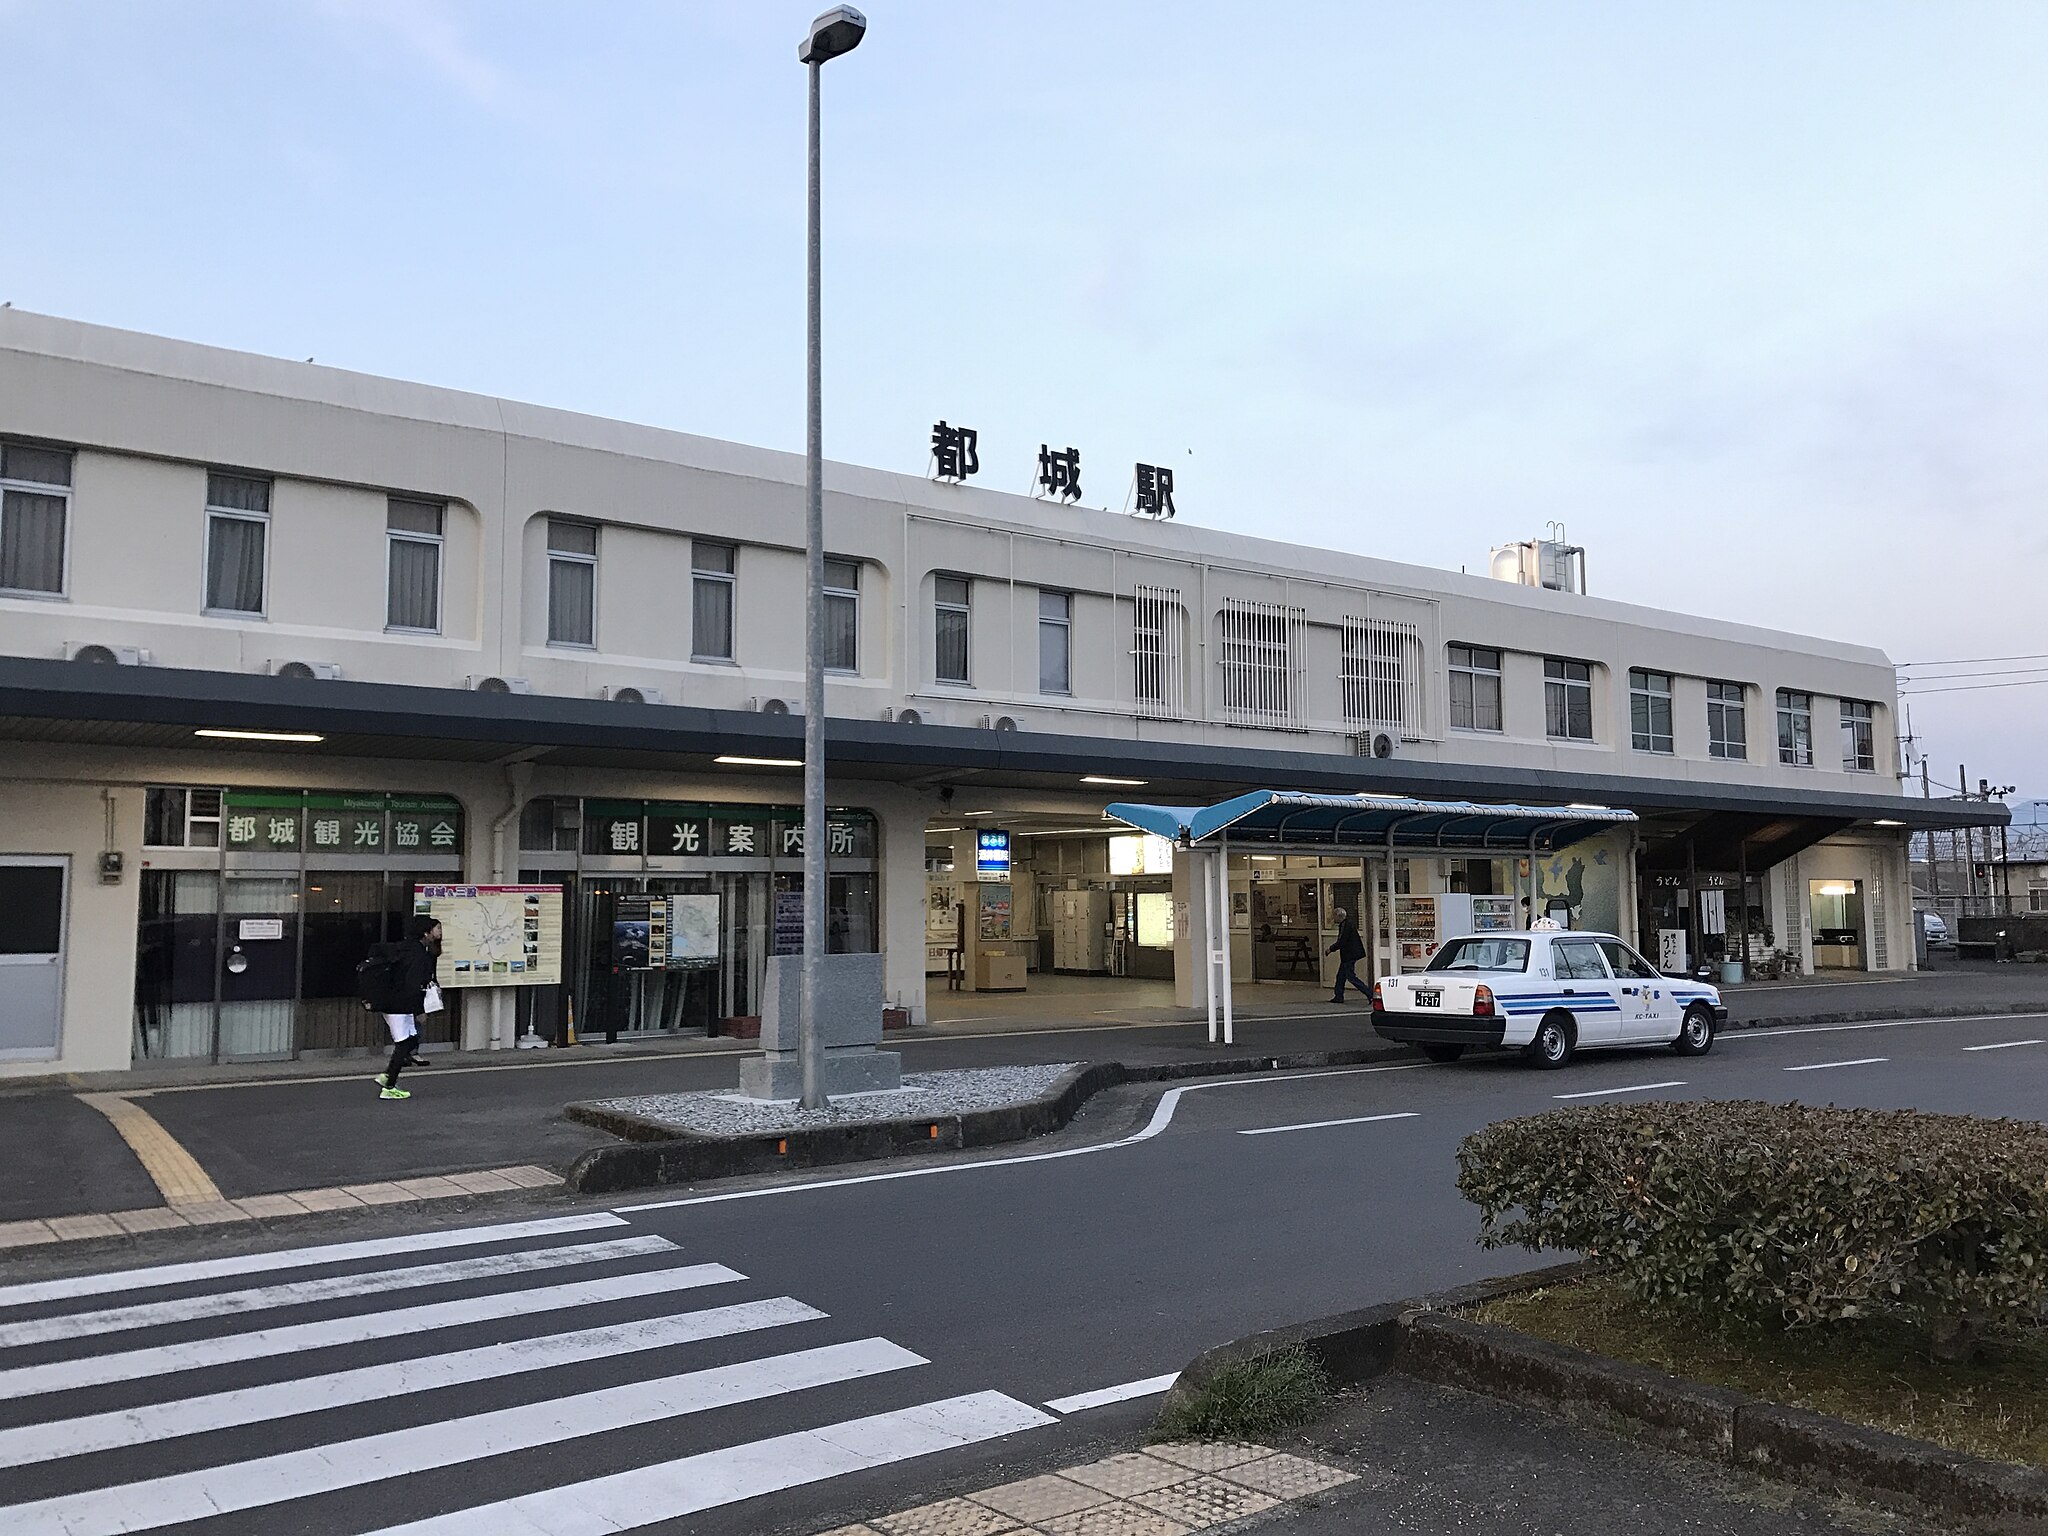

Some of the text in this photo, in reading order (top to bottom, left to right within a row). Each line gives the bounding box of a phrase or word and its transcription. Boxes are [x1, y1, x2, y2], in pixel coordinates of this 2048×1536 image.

[931, 420, 1176, 518] 都城駅
[343, 799, 385, 809] Miyakonojo
[228, 815, 455, 846] 都城観光協会
[610, 821, 854, 854] 観光案内所
[1656, 876, 1680, 886] うどん
[1708, 876, 1724, 886] うどん
[1662, 935, 1673, 969] うどん
[1539, 968, 1550, 977] 131
[1388, 979, 1399, 988] 131
